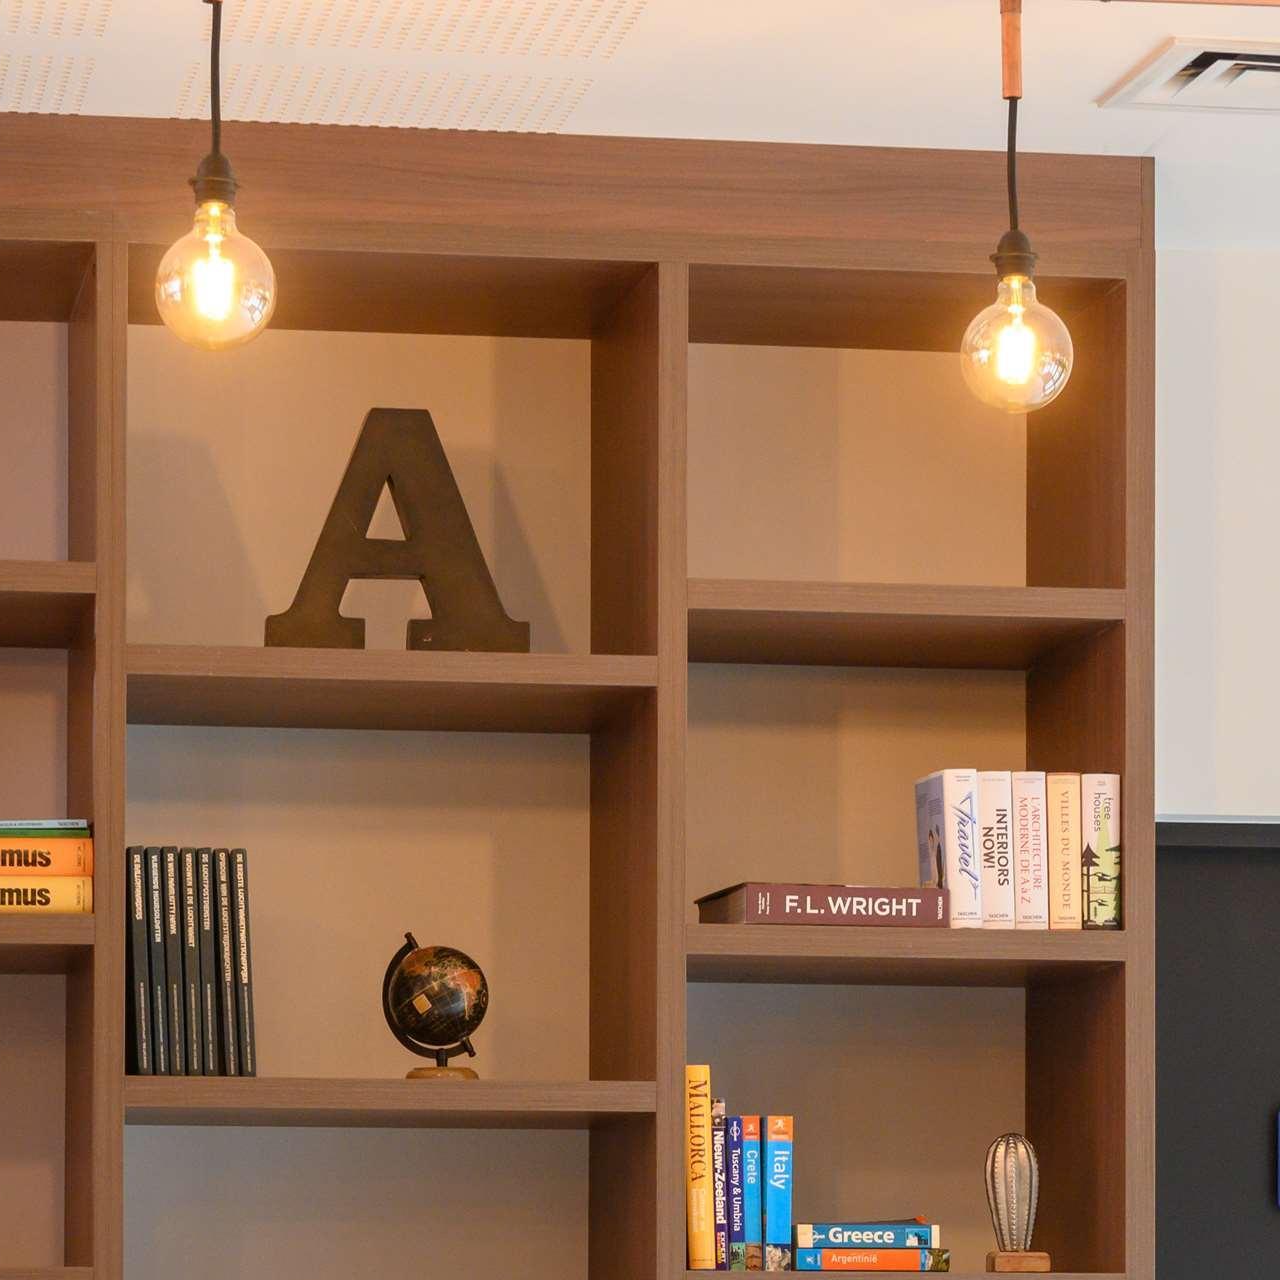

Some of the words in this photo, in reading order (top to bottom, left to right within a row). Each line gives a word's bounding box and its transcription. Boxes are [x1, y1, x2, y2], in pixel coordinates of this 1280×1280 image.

[264, 407, 530, 653] A
[1019, 797, 1030, 855] MODERNE
[1060, 790, 1069, 834] VILLES
[1094, 792, 1107, 832] houses
[1103, 797, 1114, 820] tree
[982, 826, 996, 870] NOW!
[995, 808, 1009, 886] INTERIORS
[1031, 797, 1042, 890] L'ARCHITECTURE
[1061, 837, 1070, 857] DU
[1020, 858, 1030, 875] DE
[827, 896, 922, 917] WRIGHT
[1061, 862, 1071, 912] MONDE
[688, 1080, 708, 1181] MALLORCA
[713, 1130, 727, 1224] Nieuw-Zeeland
[730, 1148, 740, 1187] Tuscany
[746, 1150, 758, 1185] Crete
[770, 1150, 790, 1190] Italy
[733, 1187, 741, 1195] &
[732, 1197, 742, 1232] Umbria
[828, 1227, 895, 1244] Greece
[831, 1253, 878, 1264] Argentinië
